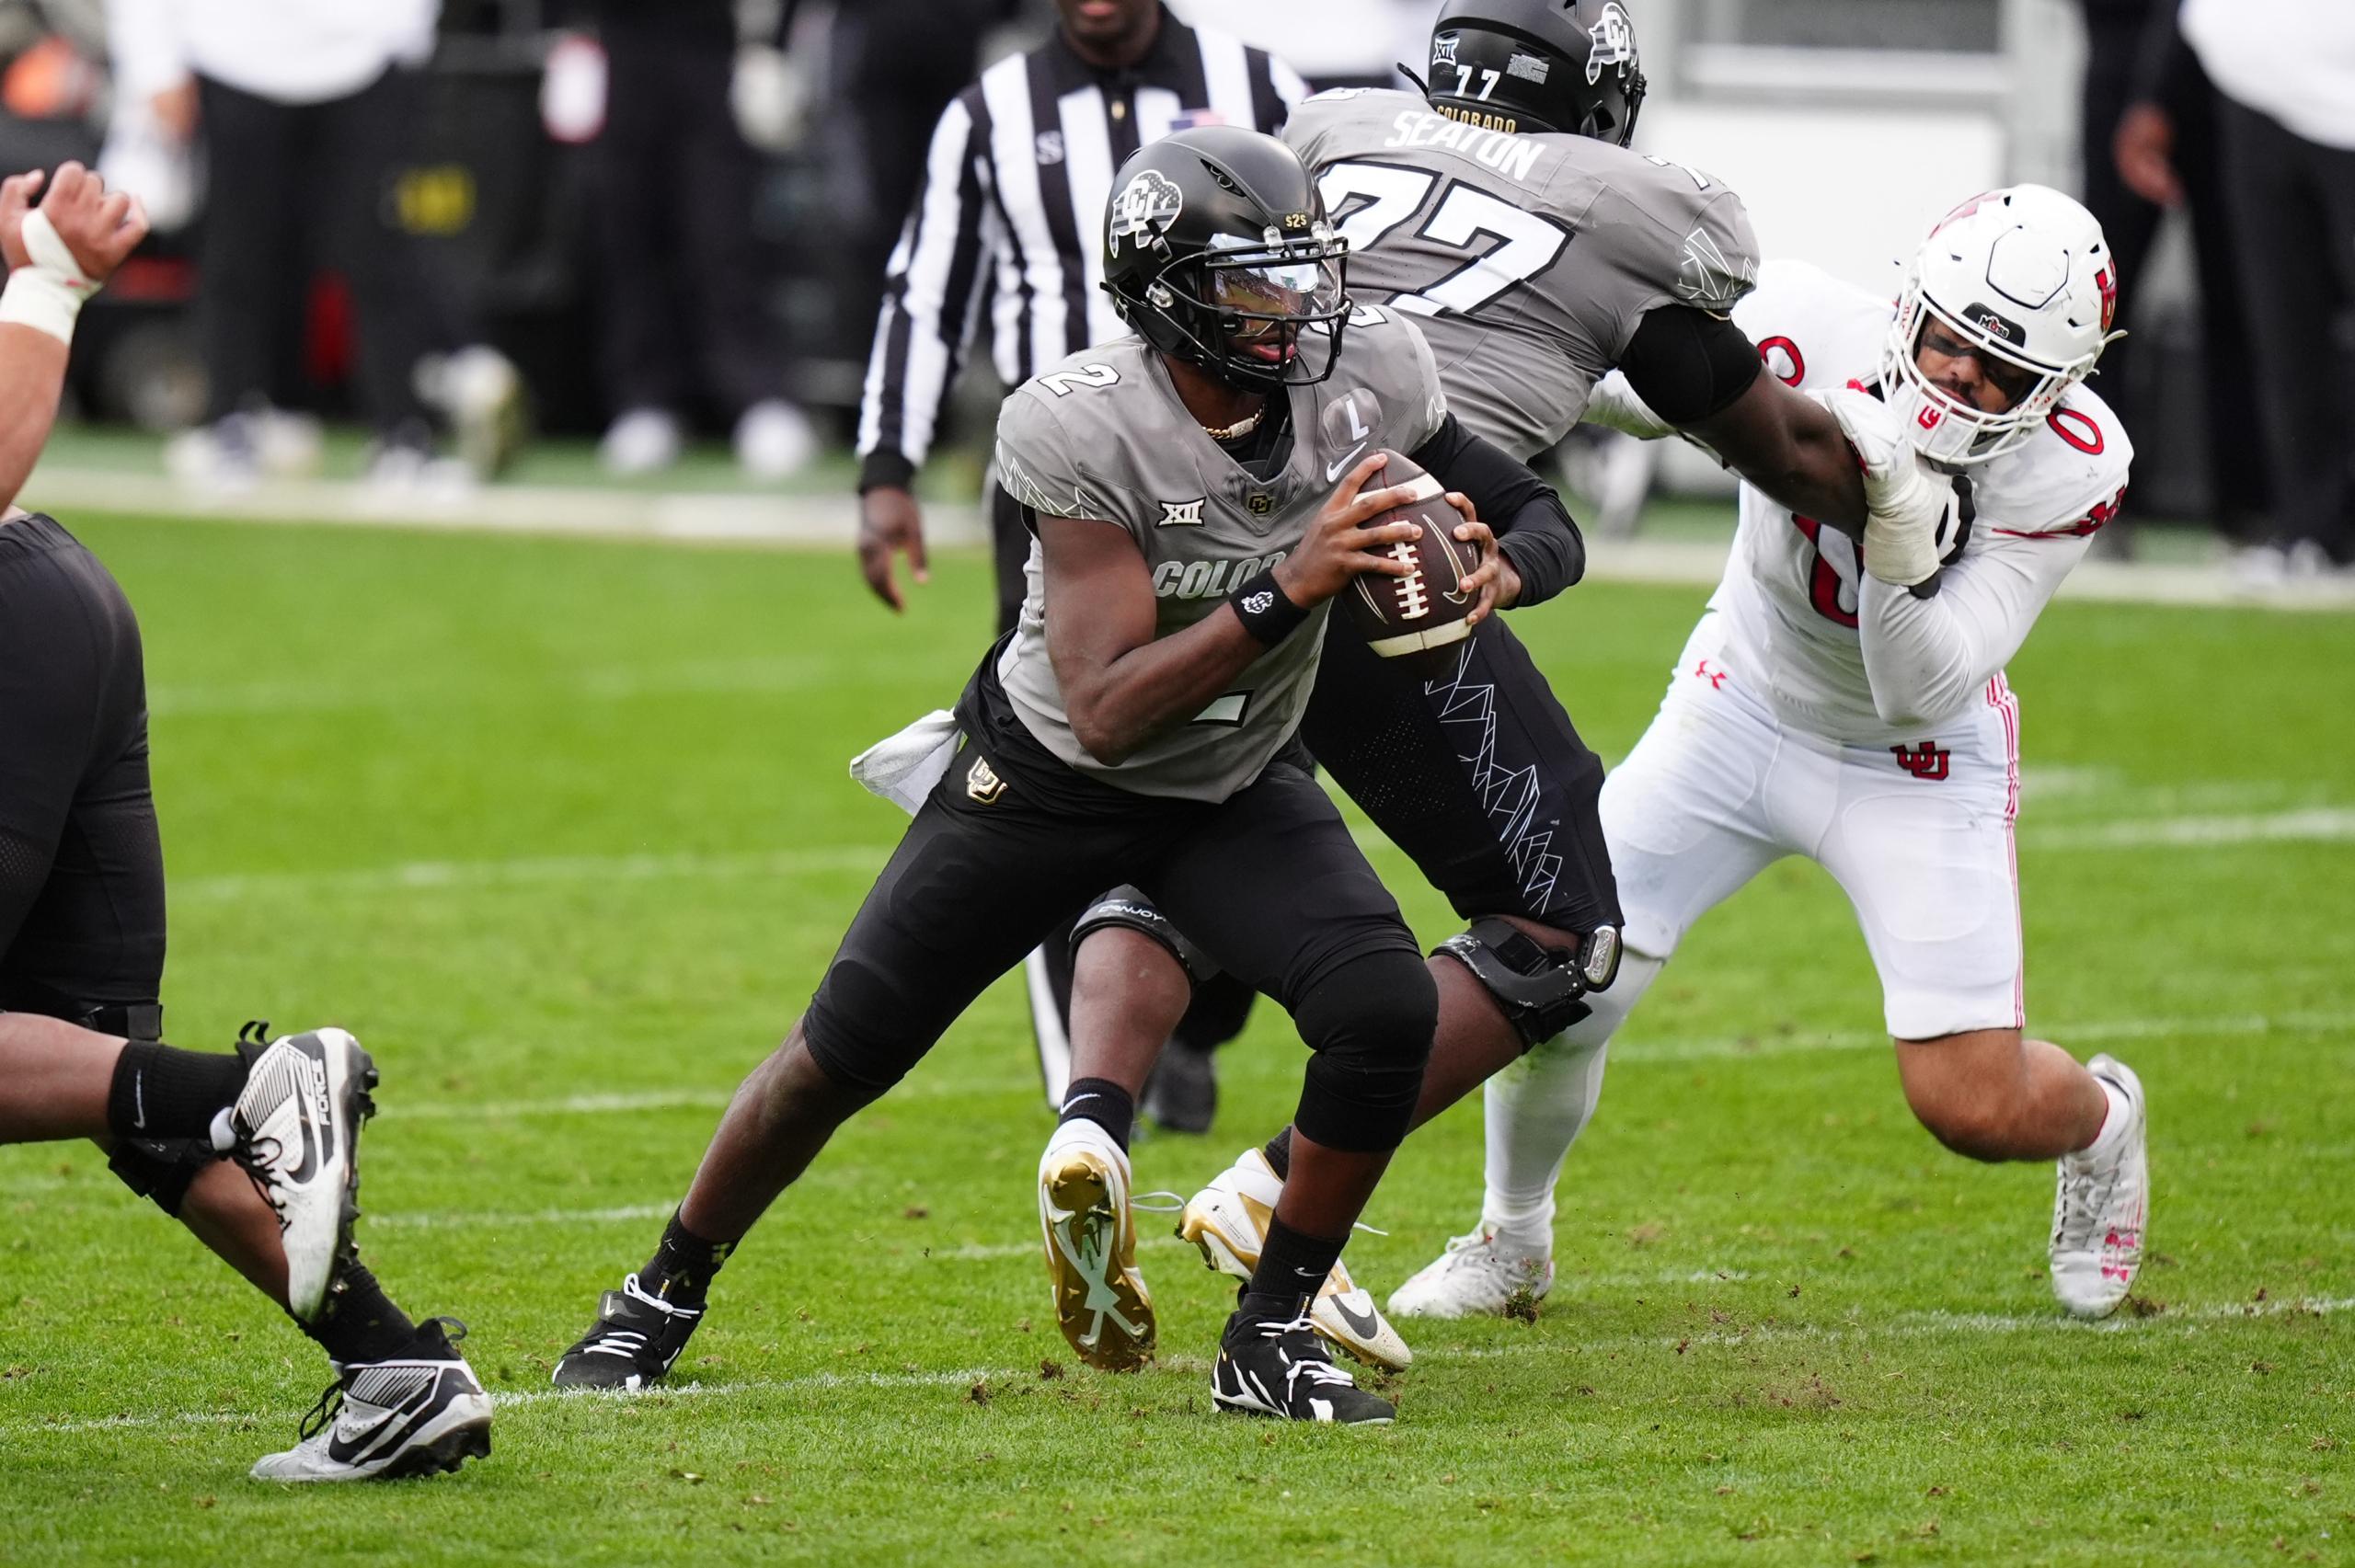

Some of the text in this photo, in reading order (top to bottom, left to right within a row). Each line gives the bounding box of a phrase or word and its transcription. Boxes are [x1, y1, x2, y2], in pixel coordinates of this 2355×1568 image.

[1454, 64, 1500, 101] 77
[1384, 110, 1547, 181] SEATON
[1315, 160, 1576, 316] 77
[1037, 363, 1121, 397] 2
[2046, 407, 2105, 455] 0
[1155, 497, 1206, 529] XII
[311, 1059, 330, 1127] FORCE
